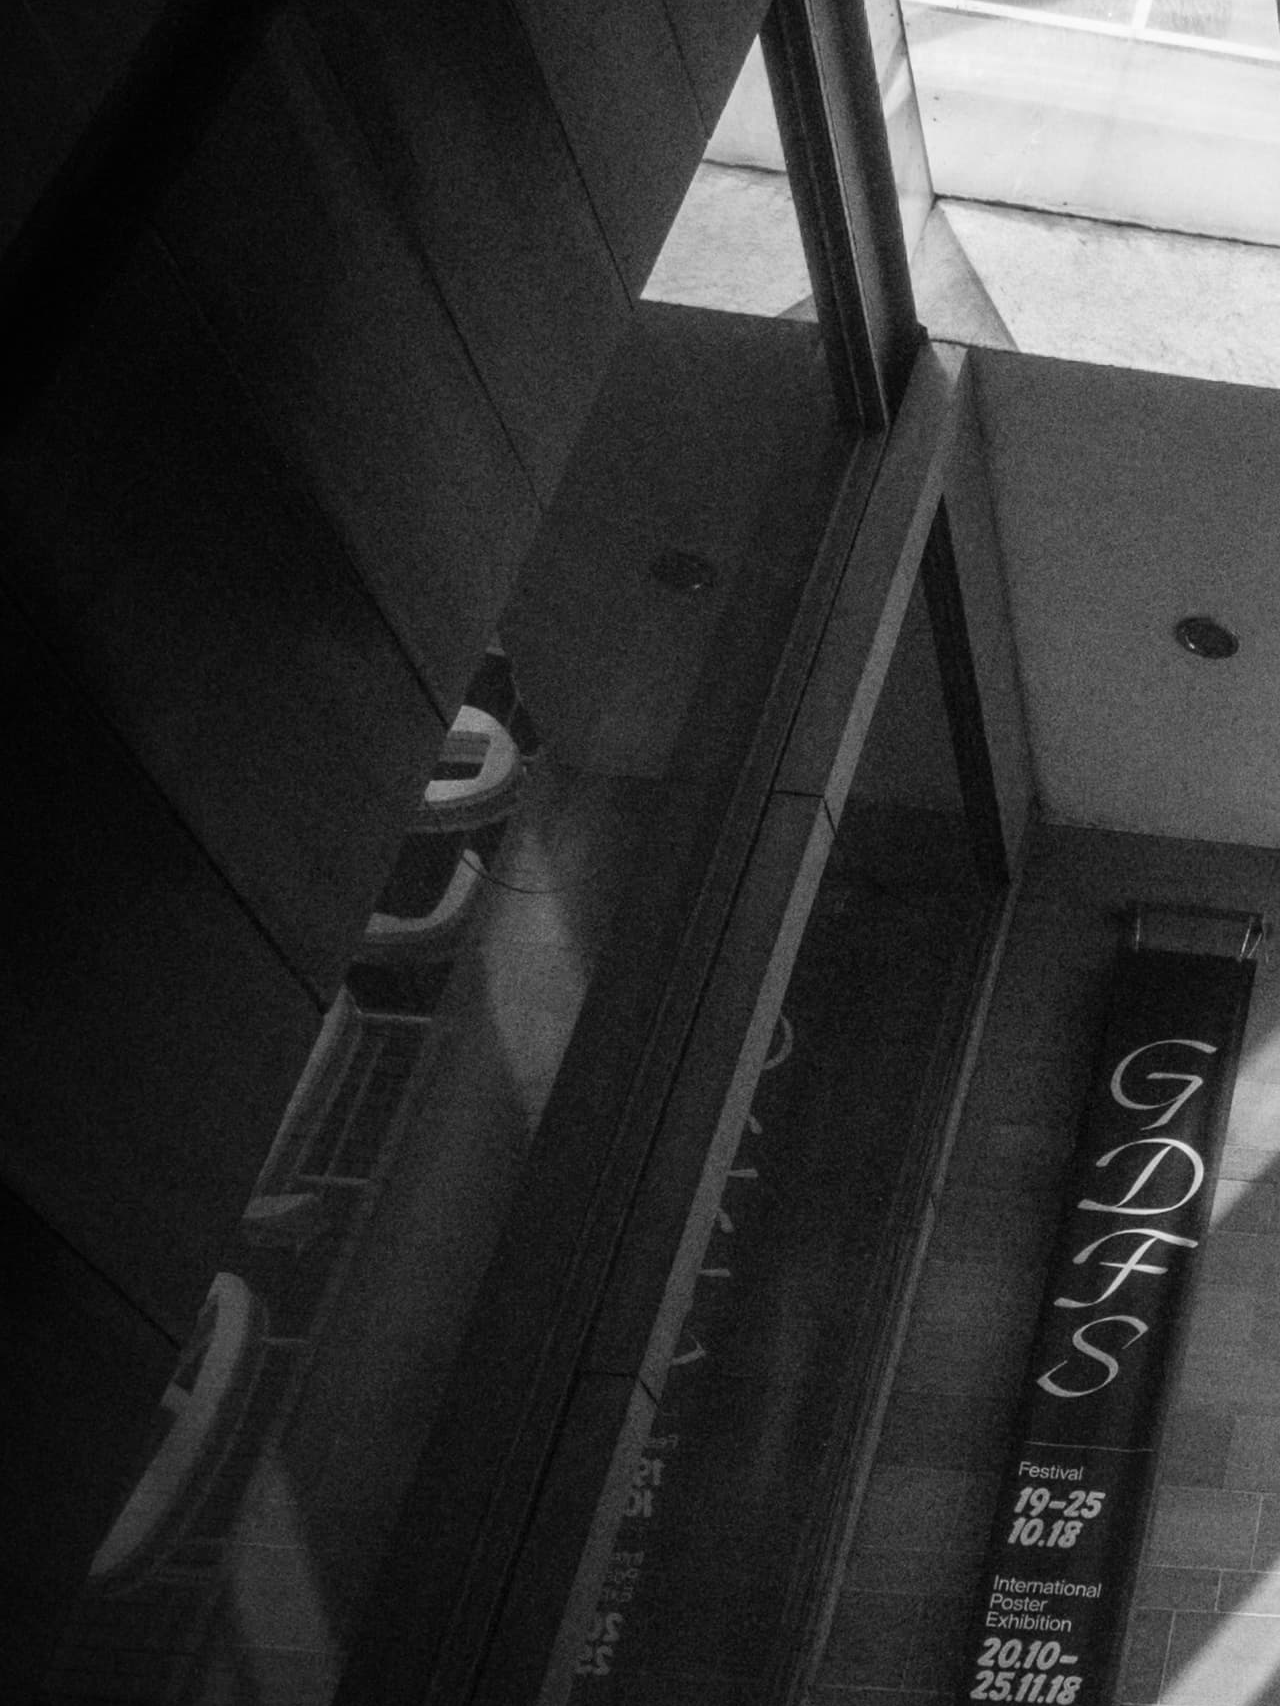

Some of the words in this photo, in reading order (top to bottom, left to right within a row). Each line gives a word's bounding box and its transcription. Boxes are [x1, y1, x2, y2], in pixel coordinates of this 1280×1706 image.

[1036, 1039, 1218, 1397] GDFS
[1018, 1462, 1084, 1482] Festival
[1007, 1519, 1082, 1548] 10.18
[993, 1575, 1102, 1599] International
[990, 1595, 1048, 1614] Poster
[985, 1612, 1073, 1633] Exhibition
[970, 1671, 1082, 1705] 25.11.18
